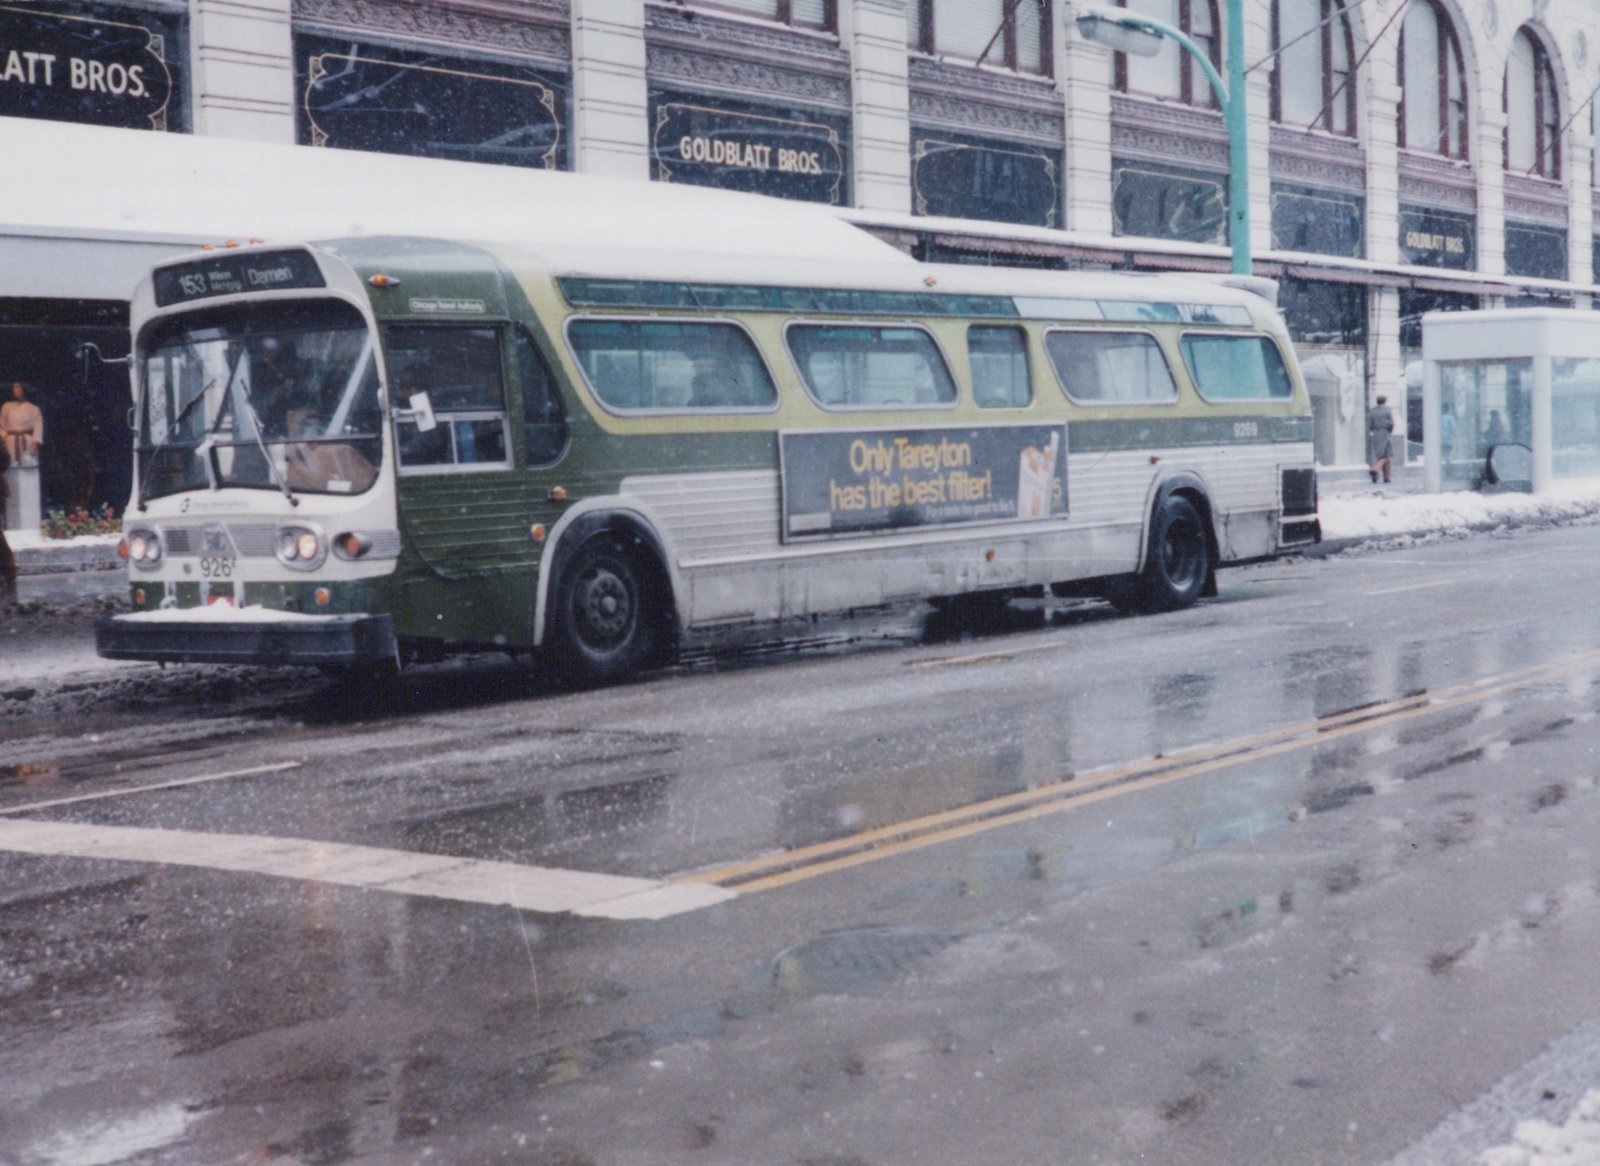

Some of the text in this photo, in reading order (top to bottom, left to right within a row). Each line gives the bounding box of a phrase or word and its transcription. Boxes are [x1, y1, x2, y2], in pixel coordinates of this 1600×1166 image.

[0, 50, 150, 98] ATT BROS.
[680, 136, 822, 176] GOLDBLATT BROS.
[179, 273, 206, 295] 153
[248, 267, 293, 285] Damen
[850, 437, 972, 475] Only Tareyton
[830, 469, 992, 511] has the best filter!
